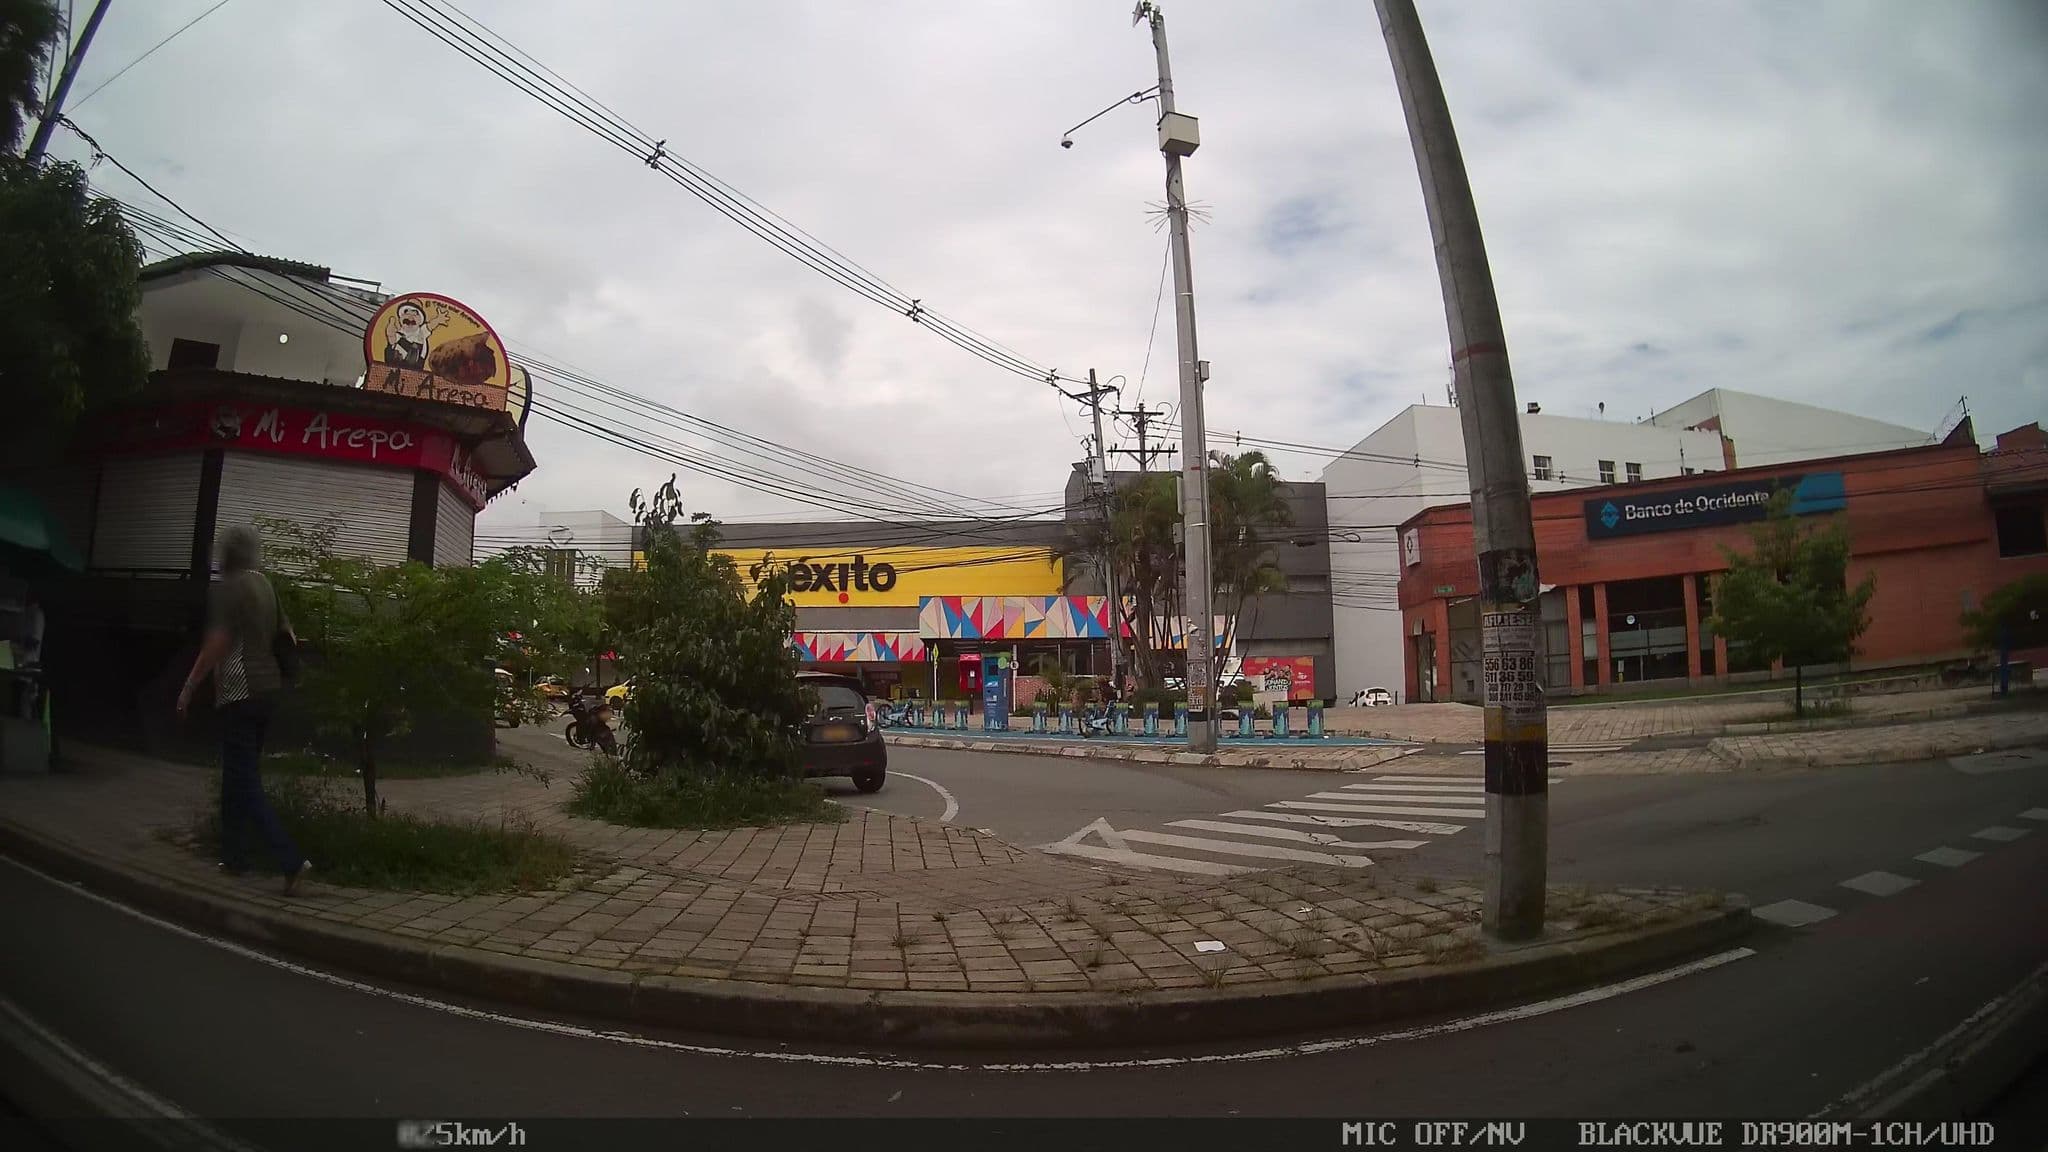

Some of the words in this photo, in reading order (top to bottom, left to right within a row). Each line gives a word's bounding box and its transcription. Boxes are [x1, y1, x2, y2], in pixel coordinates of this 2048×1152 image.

[383, 368, 405, 394] Mi
[416, 374, 488, 406] Arepa
[253, 408, 285, 443] Mi
[302, 412, 414, 458] Arepa
[1625, 503, 1672, 521] Banco
[1675, 498, 1694, 514] de
[1695, 491, 1769, 513] Occidente
[1484, 658, 1500, 672] 556
[1501, 657, 1517, 671] 63
[1519, 657, 1534, 671] 86
[1484, 671, 1498, 683] 511
[1498, 671, 1515, 682] 36
[1517, 671, 1534, 682] 59
